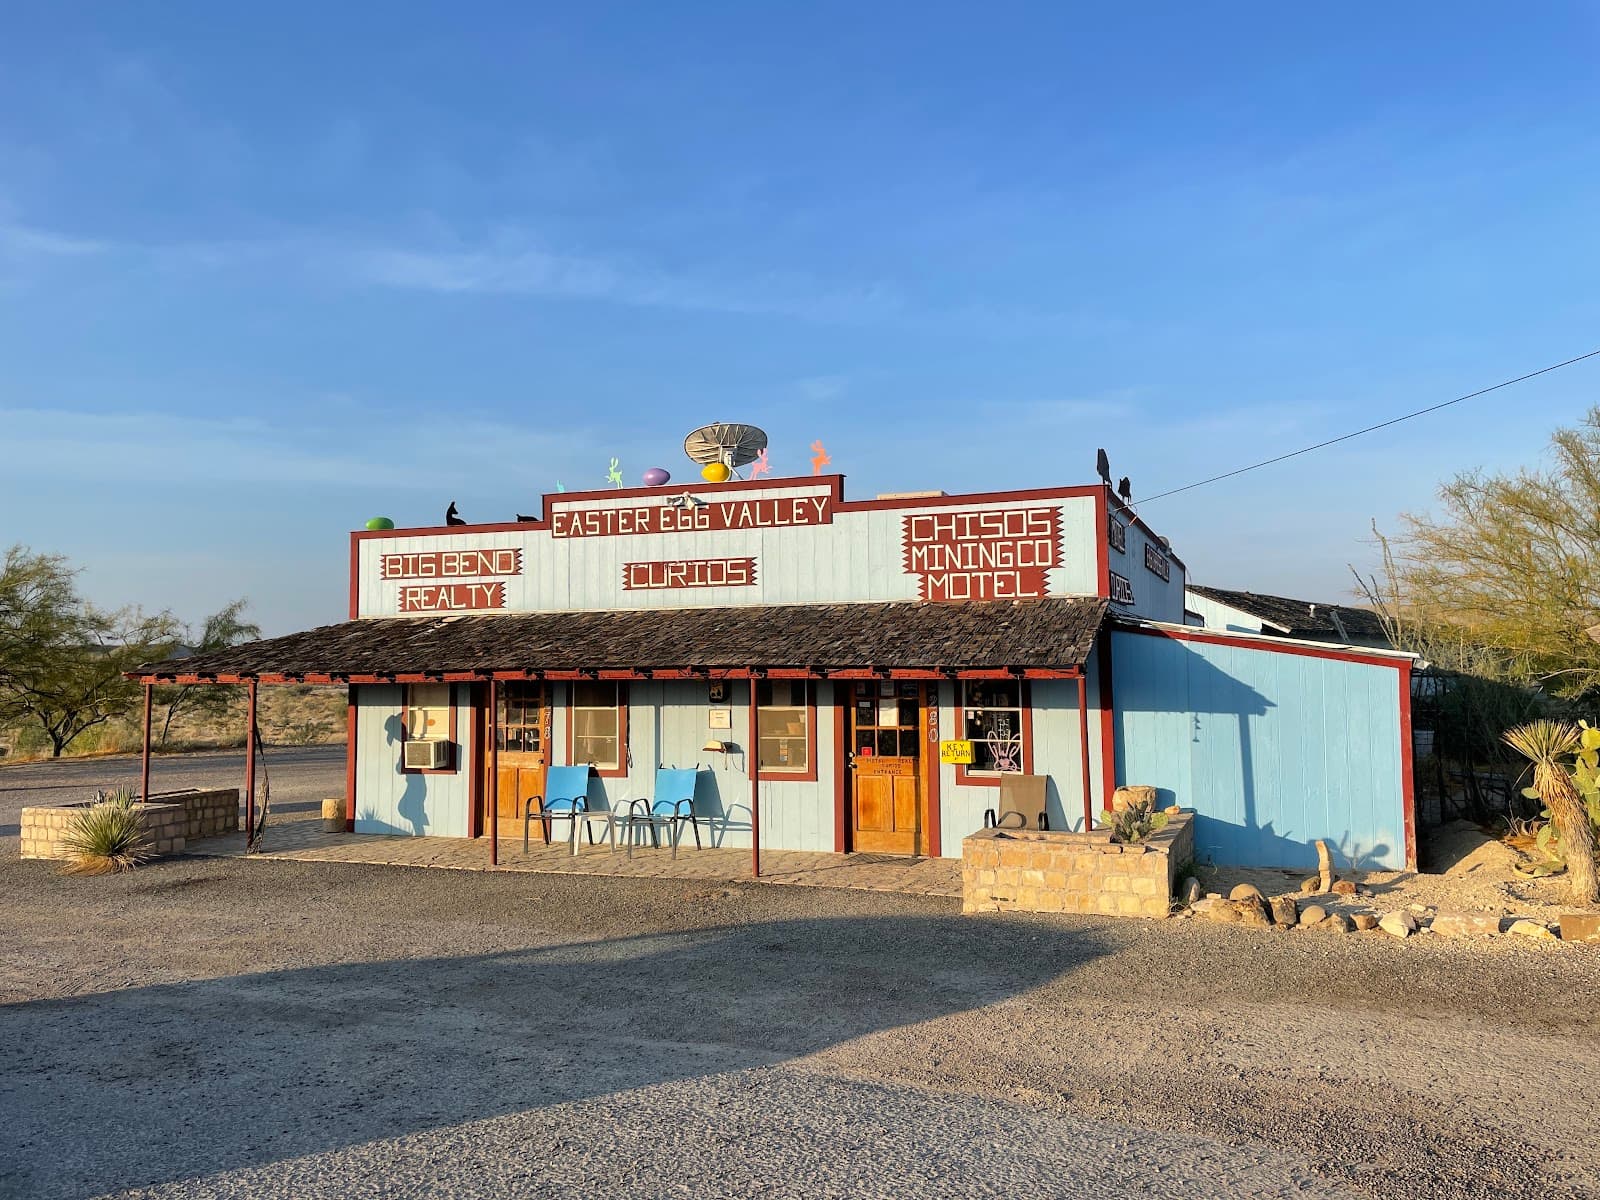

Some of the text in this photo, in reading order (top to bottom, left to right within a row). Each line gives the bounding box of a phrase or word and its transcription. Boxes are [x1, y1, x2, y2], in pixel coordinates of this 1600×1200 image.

[553, 497, 828, 537] EASTER EGG VALLEY
[911, 508, 1052, 542] CHISOS
[385, 550, 514, 578] BIG BEND
[911, 539, 1053, 571] MINING CO
[630, 559, 747, 588] CURIOS
[927, 570, 1039, 600] MOTEL
[406, 583, 497, 610] REALTY
[941, 749, 971, 758] RETURN
